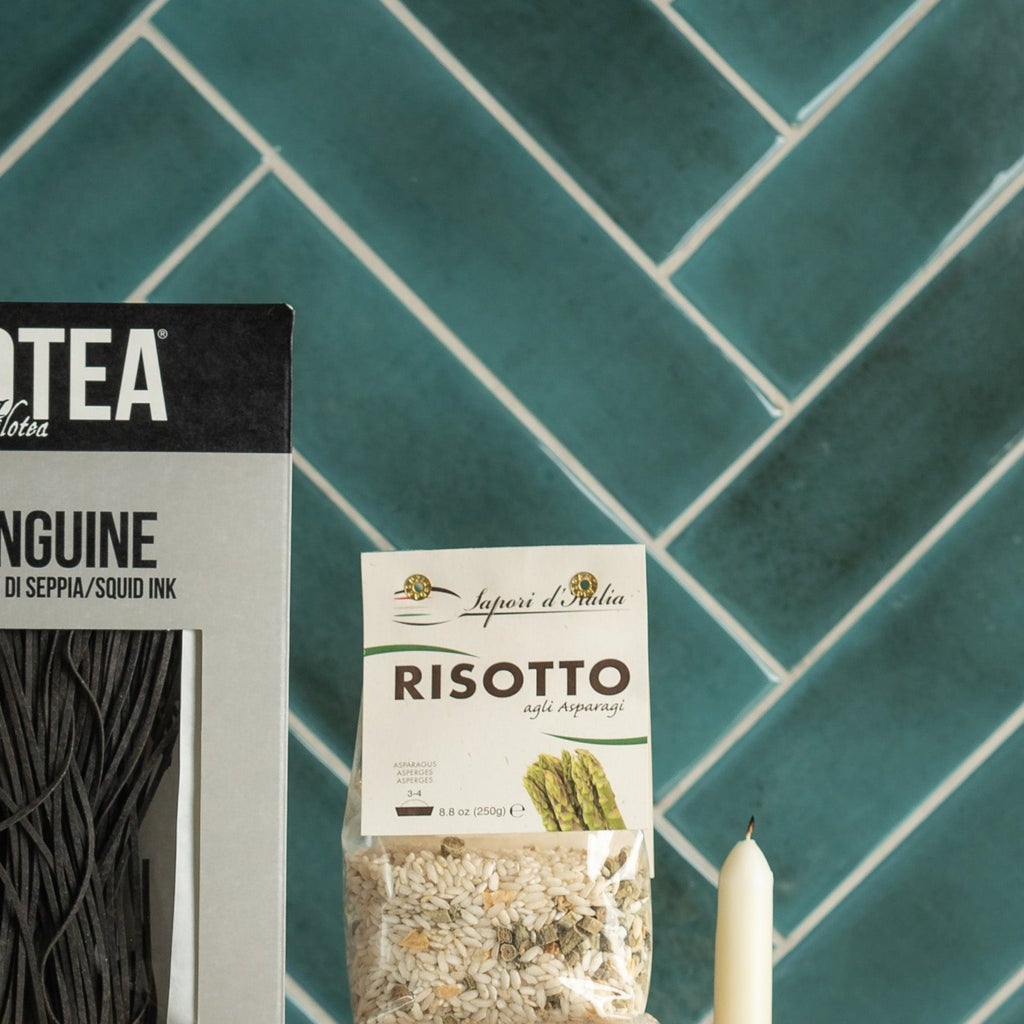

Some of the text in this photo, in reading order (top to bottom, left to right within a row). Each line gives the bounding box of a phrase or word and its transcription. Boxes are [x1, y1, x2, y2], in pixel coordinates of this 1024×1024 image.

[5, 577, 21, 598] DI
[26, 577, 144, 600] SEPPIA/SQUID
[149, 578, 177, 600] INK
[463, 587, 535, 628] Sapori
[394, 658, 631, 701] RISOTTO
[523, 700, 625, 720] agli Asparagi
[393, 761, 437, 769] ASPARAGUS
[439, 808, 455, 817] 8.8
[473, 807, 506, 818] (250g)
